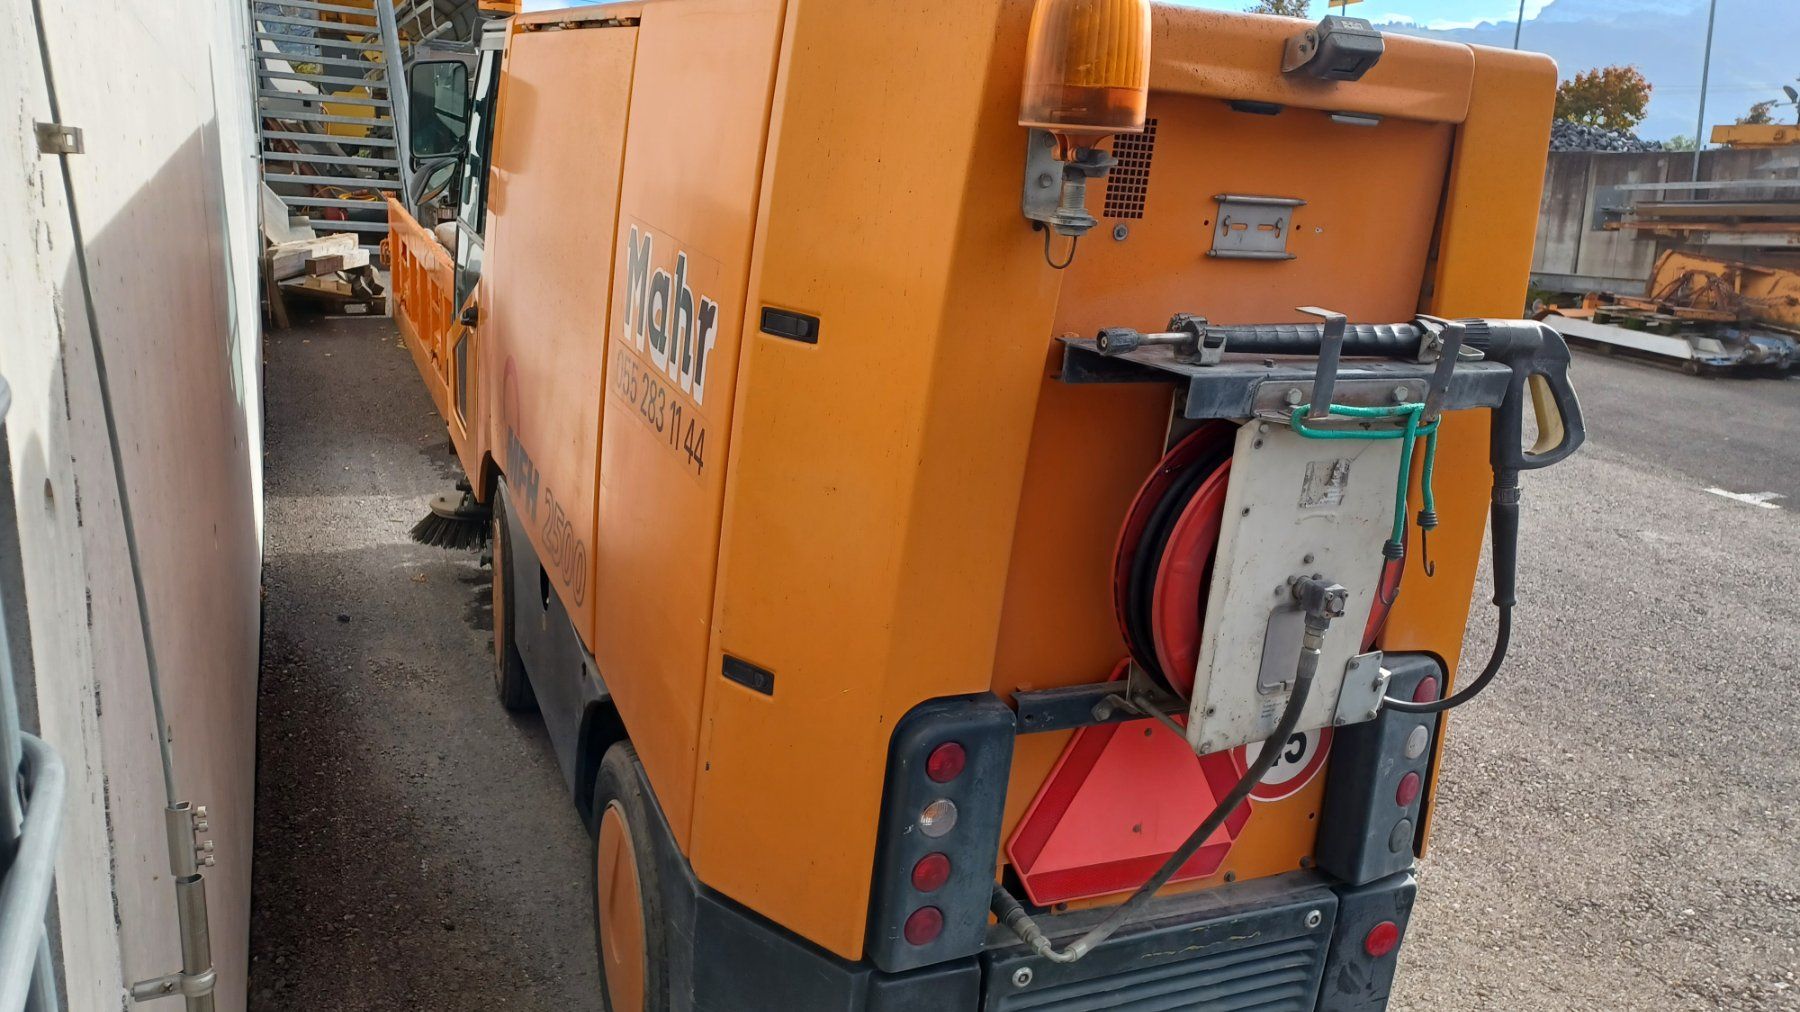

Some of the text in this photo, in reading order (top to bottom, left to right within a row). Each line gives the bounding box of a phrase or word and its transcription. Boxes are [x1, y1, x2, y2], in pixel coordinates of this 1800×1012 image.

[624, 224, 718, 406] Mahr
[616, 349, 705, 476] 055 283 11 44
[542, 486, 586, 607] 2500
